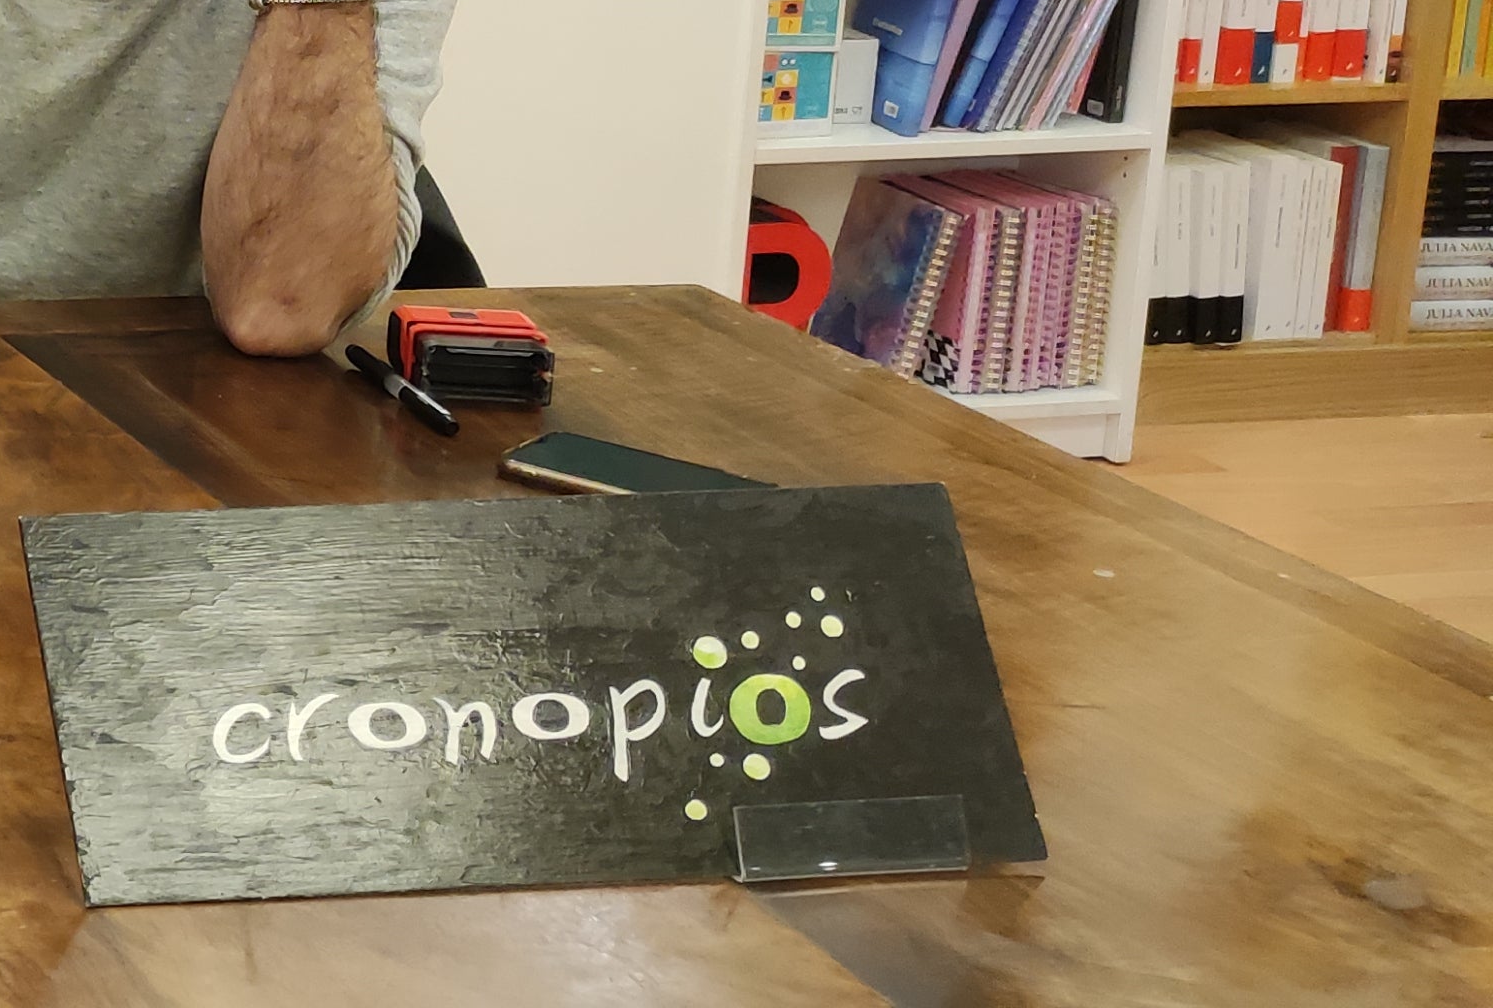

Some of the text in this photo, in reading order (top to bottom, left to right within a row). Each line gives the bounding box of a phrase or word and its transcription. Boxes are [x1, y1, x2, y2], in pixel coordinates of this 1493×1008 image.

[1420, 242, 1457, 253] JULIA
[1425, 278, 1462, 288] JULIA
[1425, 308, 1463, 319] JULIA
[213, 635, 871, 783] cronopios
